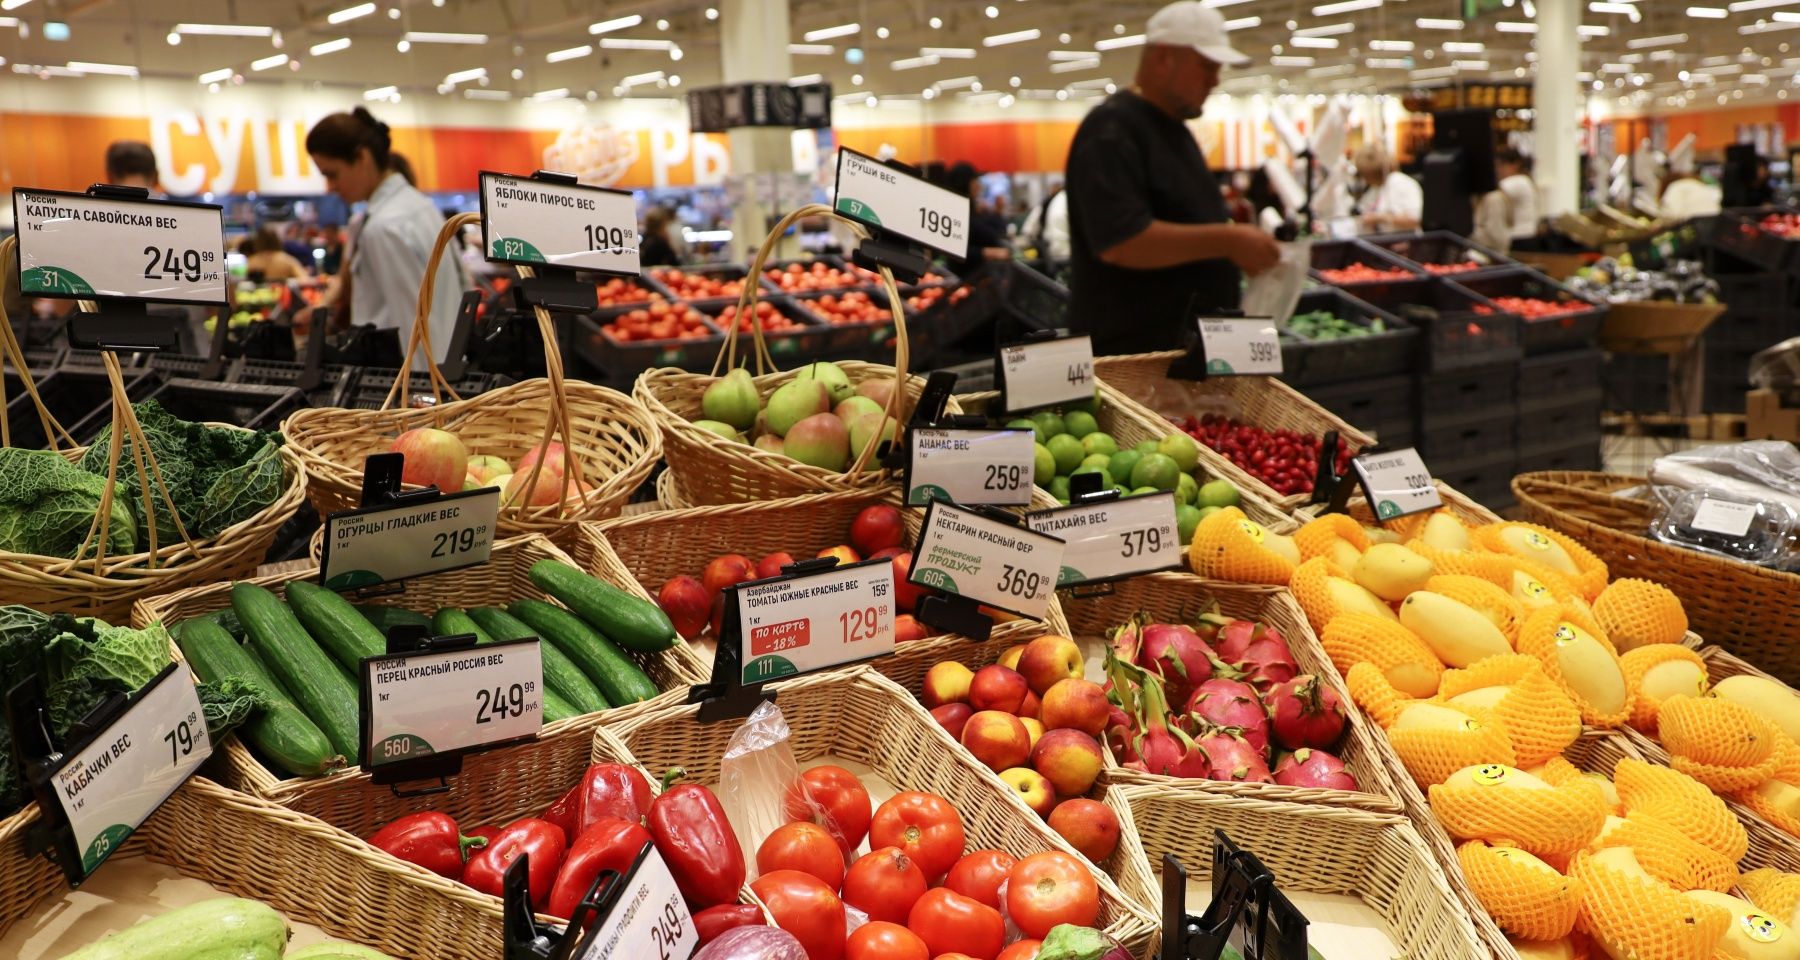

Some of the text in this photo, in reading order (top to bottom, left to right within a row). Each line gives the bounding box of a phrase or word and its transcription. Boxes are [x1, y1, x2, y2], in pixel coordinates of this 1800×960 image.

[149, 108, 328, 197] СУШ
[494, 177, 518, 187] Россия
[847, 159, 896, 184] ГРУШИ ВЕС
[26, 195, 56, 204] Россия
[496, 186, 596, 211] ЯБЛОКИ ПИРОС ВЕС
[850, 201, 862, 214] 57
[26, 205, 177, 229] КАПУСТА САВОЙСКАЯ ВЕС
[919, 207, 952, 238] 199
[504, 240, 524, 257] 621
[584, 224, 633, 255] 199 99
[143, 246, 214, 282] 249 99
[42, 271, 58, 287] 31
[203, 272, 219, 280] руб.
[1249, 342, 1272, 362] 399
[1068, 363, 1085, 386] 44
[919, 439, 970, 450] АНАНАС ВЕС
[984, 465, 1020, 490] 259
[922, 487, 935, 500] 95
[338, 517, 364, 526] Россия
[338, 507, 460, 539] ОГУРЦЫ ГЛАДКИЕ ВЕС
[939, 508, 959, 520] Россия
[1034, 512, 1108, 532] ПИТАХАЙЯ ВЕС
[431, 525, 486, 559] 219 99
[936, 518, 1033, 554] НЕКТАРИН КРАСНЫЙ ФЕР
[1120, 526, 1170, 558] 379 99
[927, 554, 981, 575] ПРОДУКТ
[746, 582, 791, 598] Азербайджан
[924, 570, 945, 587] 605
[997, 564, 1049, 600] 369 99
[747, 595, 779, 608] ТОМАТЫ
[780, 588, 810, 603] ЮЖНЫЕ
[811, 582, 844, 599] КРАСНЫЕ
[845, 580, 859, 590] ВЕС
[872, 584, 886, 597] 159
[840, 605, 888, 644] 129 99
[766, 635, 796, 651] -18%
[376, 658, 406, 671] РОССИЯ
[377, 654, 504, 684] ПЕРЕЦ КРАСНЫЙ РОССИЯ ВЕС
[758, 658, 773, 676] 111
[476, 681, 535, 725] 249 99
[164, 712, 196, 768] 79 99
[384, 737, 410, 757] 560
[60, 760, 84, 784] Россия
[65, 734, 131, 800] КАБАЧКИ ВЕС
[78, 798, 85, 808] кг
[95, 833, 110, 858] 25
[638, 884, 649, 901] ВЕС
[651, 902, 682, 960] 249
